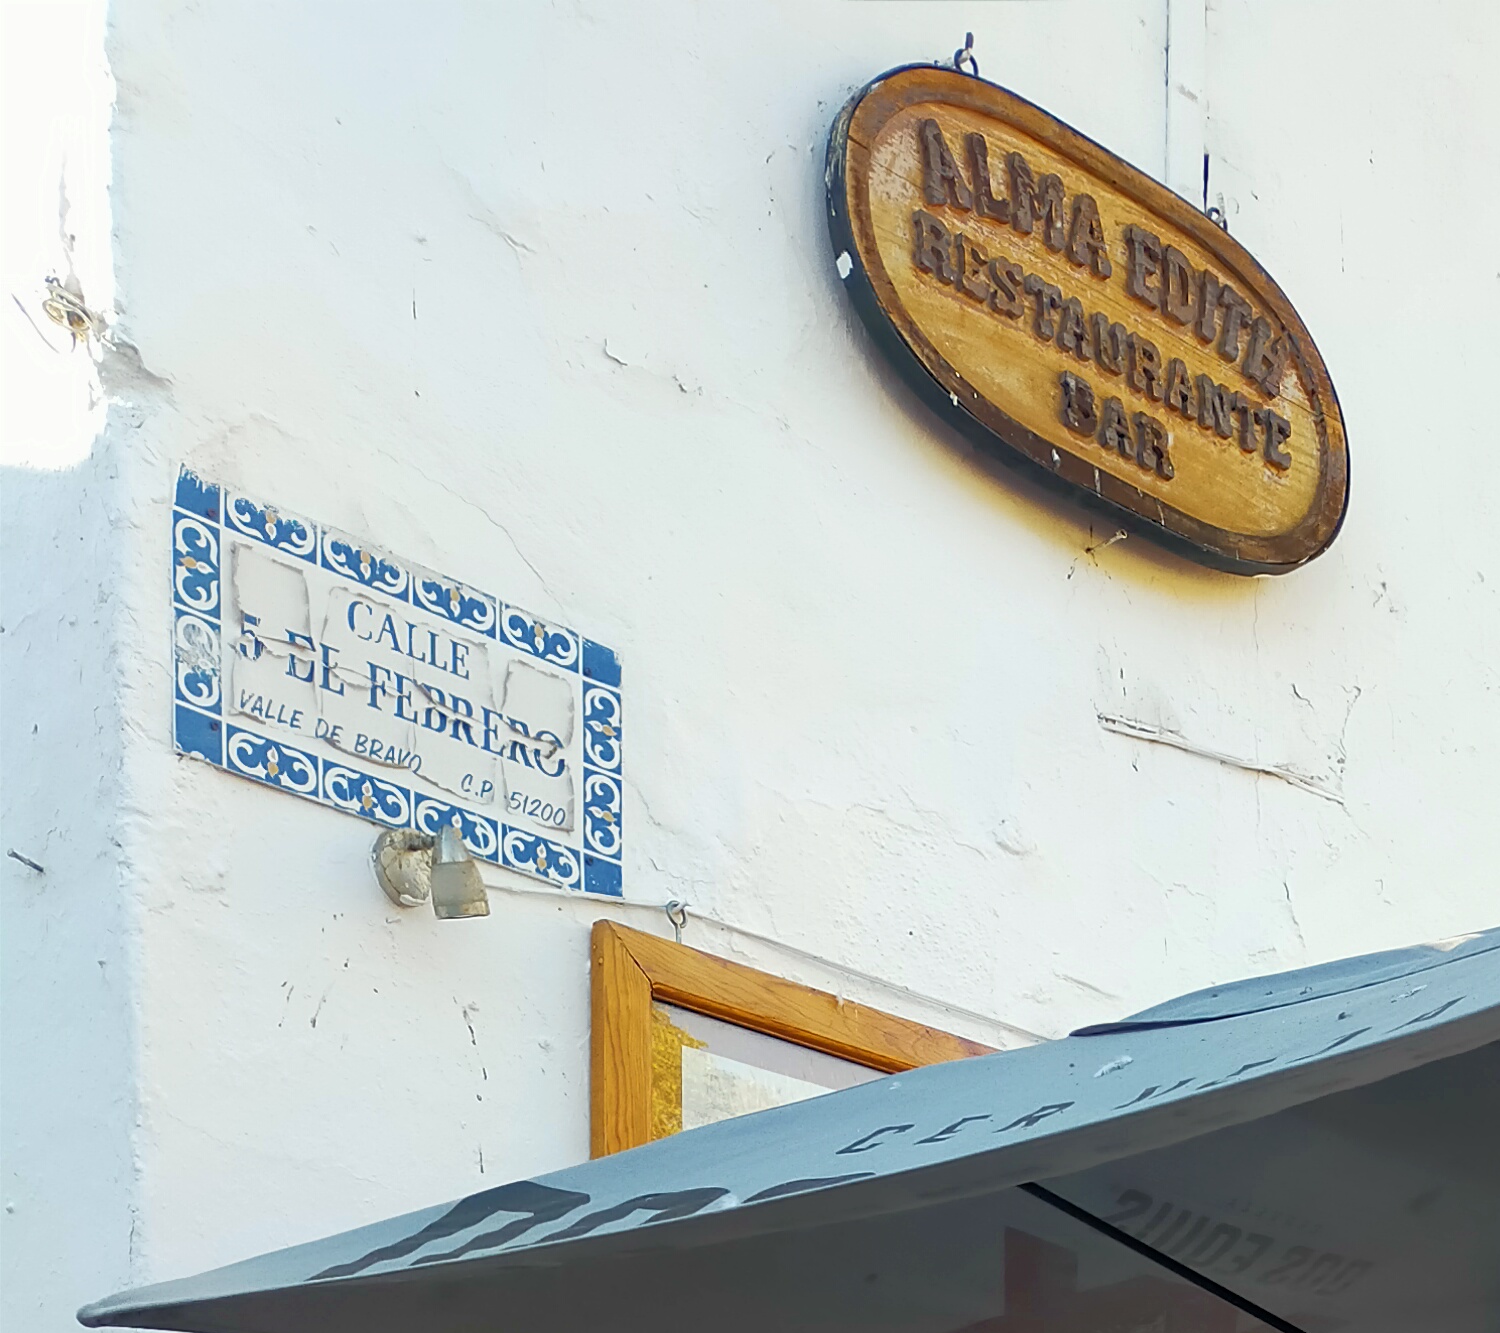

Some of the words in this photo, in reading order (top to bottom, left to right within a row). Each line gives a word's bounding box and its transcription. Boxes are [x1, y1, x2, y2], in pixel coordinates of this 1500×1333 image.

[918, 117, 1113, 282] ALMA
[1124, 222, 1292, 400] EDITH
[911, 208, 1293, 472] RESTAURANTE
[1058, 368, 1176, 482] BAR
[239, 610, 265, 661] 5
[366, 660, 566, 778] FEBRERO
[347, 600, 471, 681] CALLE
[240, 688, 304, 730] VALLE
[314, 717, 344, 745] DE
[354, 733, 422, 775] BRAVO
[509, 791, 566, 826] 51200
